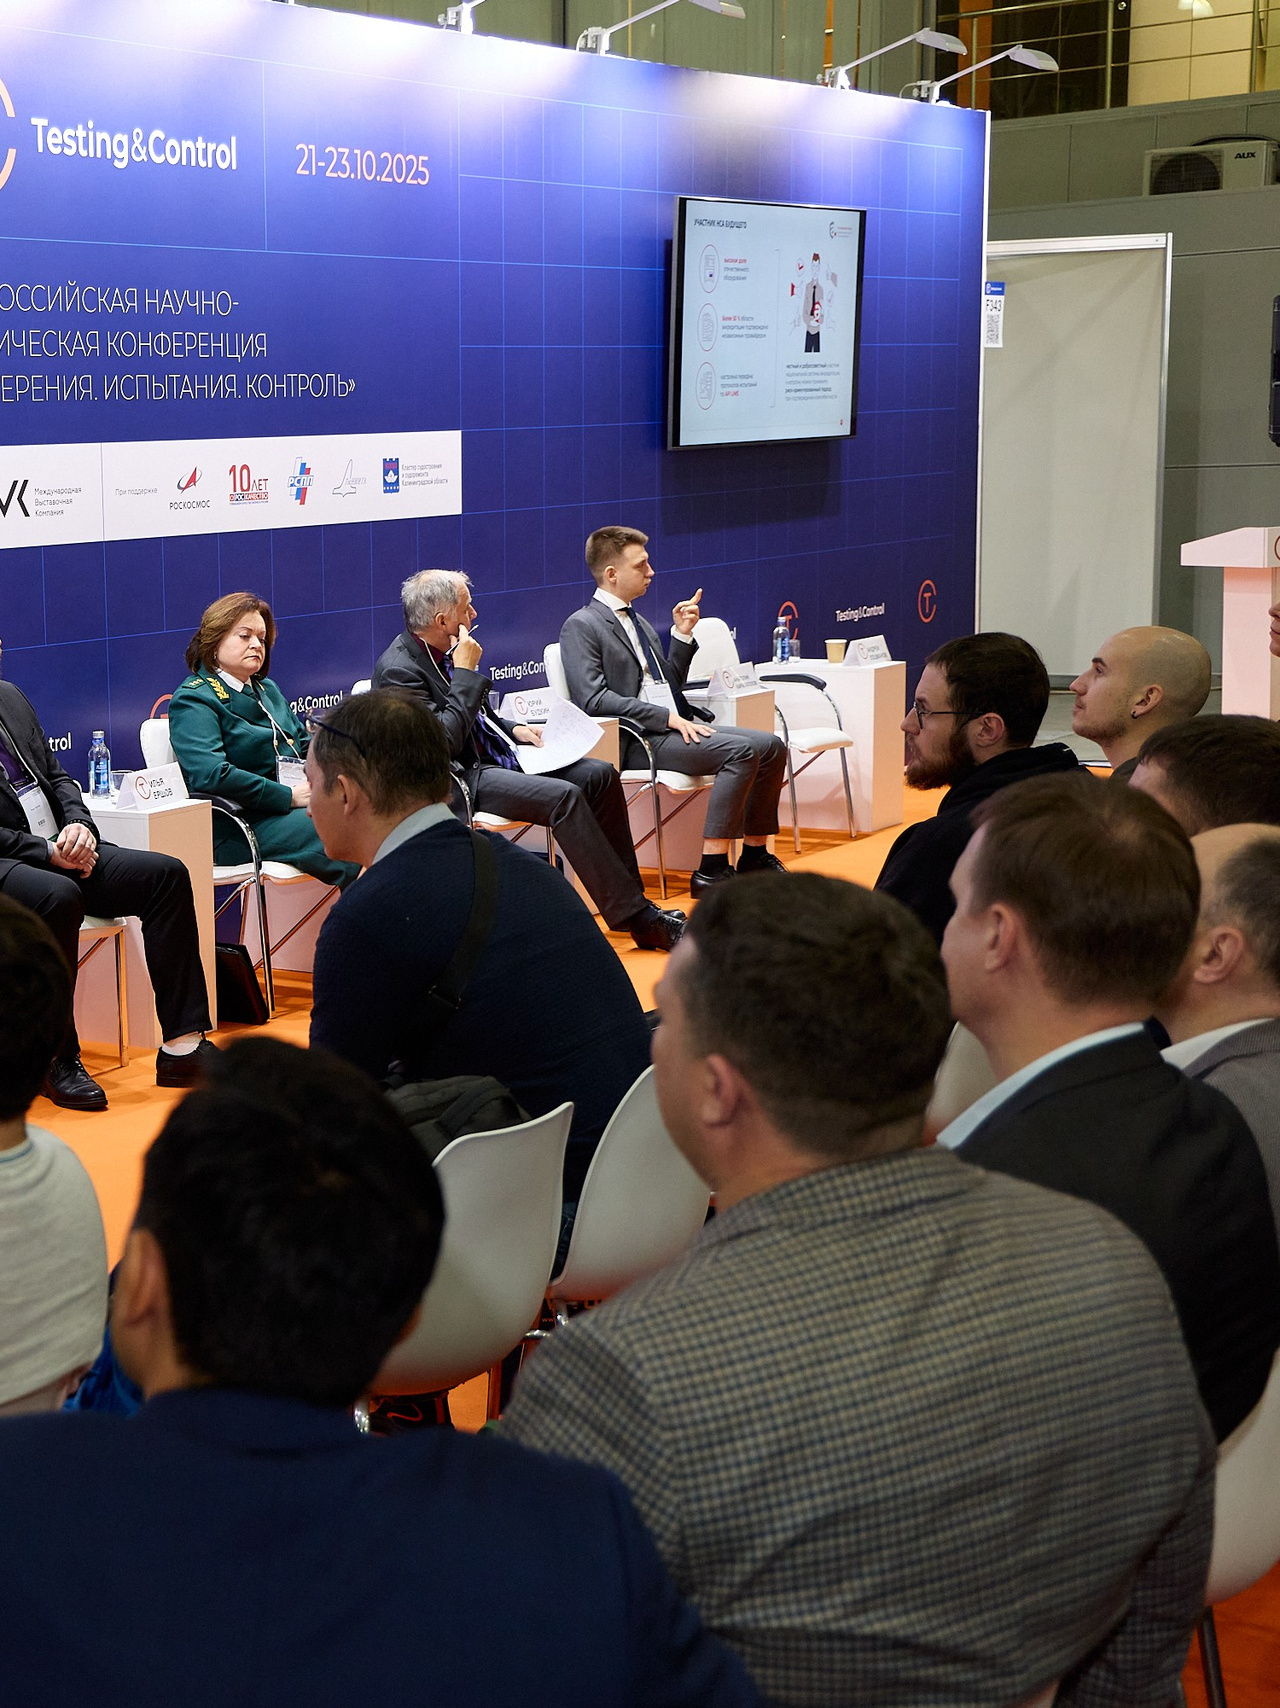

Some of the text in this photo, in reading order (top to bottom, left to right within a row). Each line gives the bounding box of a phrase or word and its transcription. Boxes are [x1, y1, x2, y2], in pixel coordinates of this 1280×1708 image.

[31, 118, 237, 170] Testing&Control
[1234, 151, 1256, 159] AUX
[295, 143, 430, 186] 21-23.10.2025
[145, 288, 239, 316] НАУЧНО-
[107, 331, 267, 363] КОНФЕРЕНЦИЯ
[103, 373, 243, 402] ИСПЫТАНИЯ.
[246, 373, 356, 399] КОНТРОЛЬ»
[229, 463, 269, 493] 10 ЛЕТ
[288, 476, 314, 488] РСПП
[34, 486, 82, 497] Международная
[34, 497, 73, 507] Выставочная
[169, 499, 211, 511] РОСКОСМОС
[34, 508, 64, 518] Компания
[836, 603, 885, 622] Testing&Control
[148, 777, 165, 788] ИЛЬЯ
[153, 788, 173, 800] ЕРШОВ
